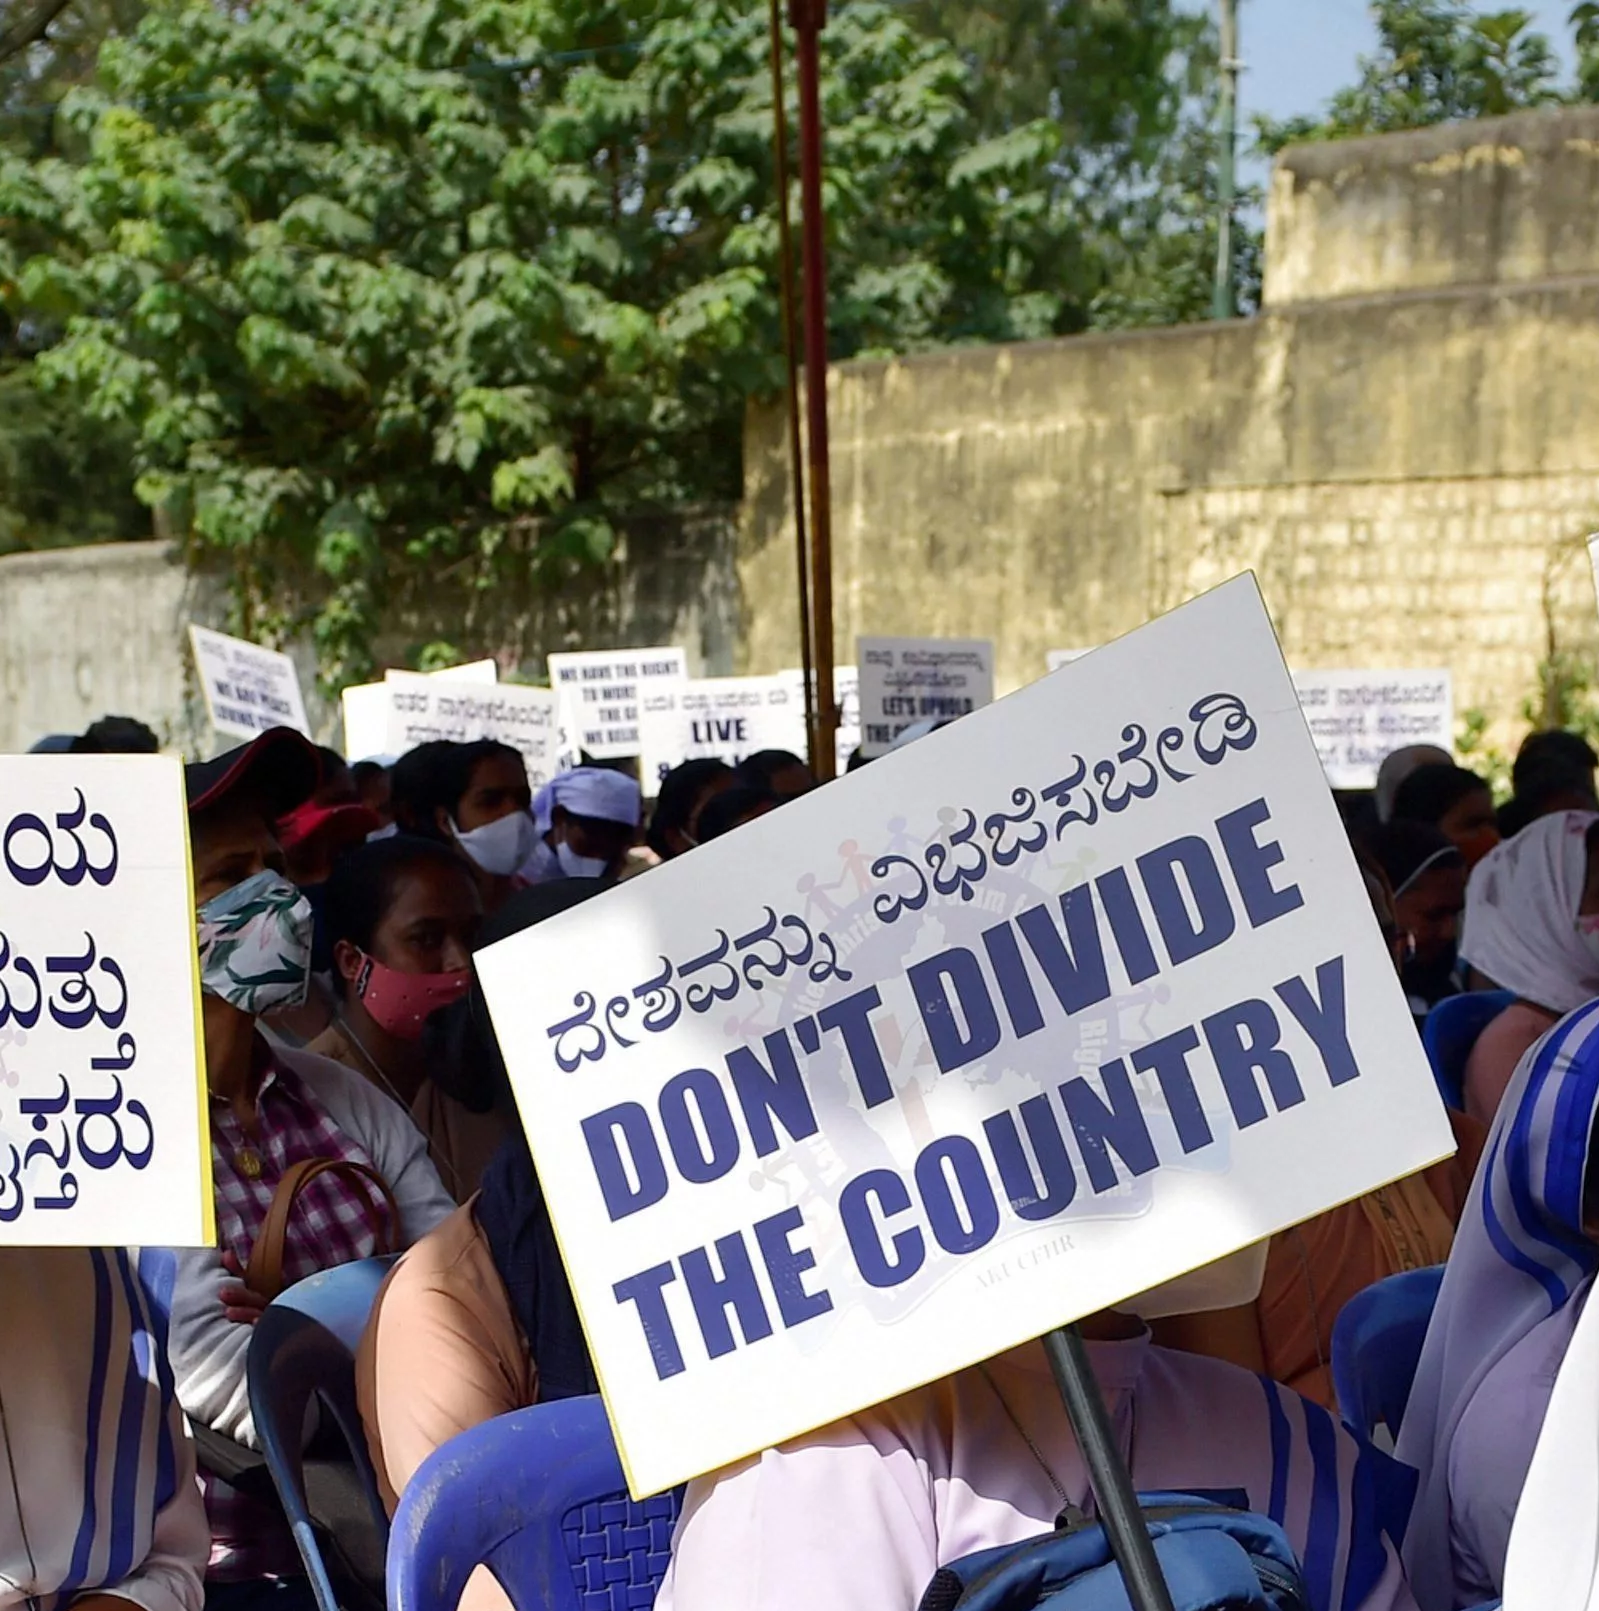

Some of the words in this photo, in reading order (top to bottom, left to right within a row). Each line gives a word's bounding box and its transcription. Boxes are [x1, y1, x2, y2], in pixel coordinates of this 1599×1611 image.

[548, 907, 852, 1072] ದೇಶವನ್ನು
[872, 694, 1256, 923] ವಿಭಜಿಸಬೇಡಿ
[691, 718, 748, 743] LIVE
[581, 985, 894, 1221] DON'T
[906, 798, 1304, 1074] DIVIDE
[613, 1206, 833, 1380] THE
[839, 955, 1360, 1287] COUNTRY
